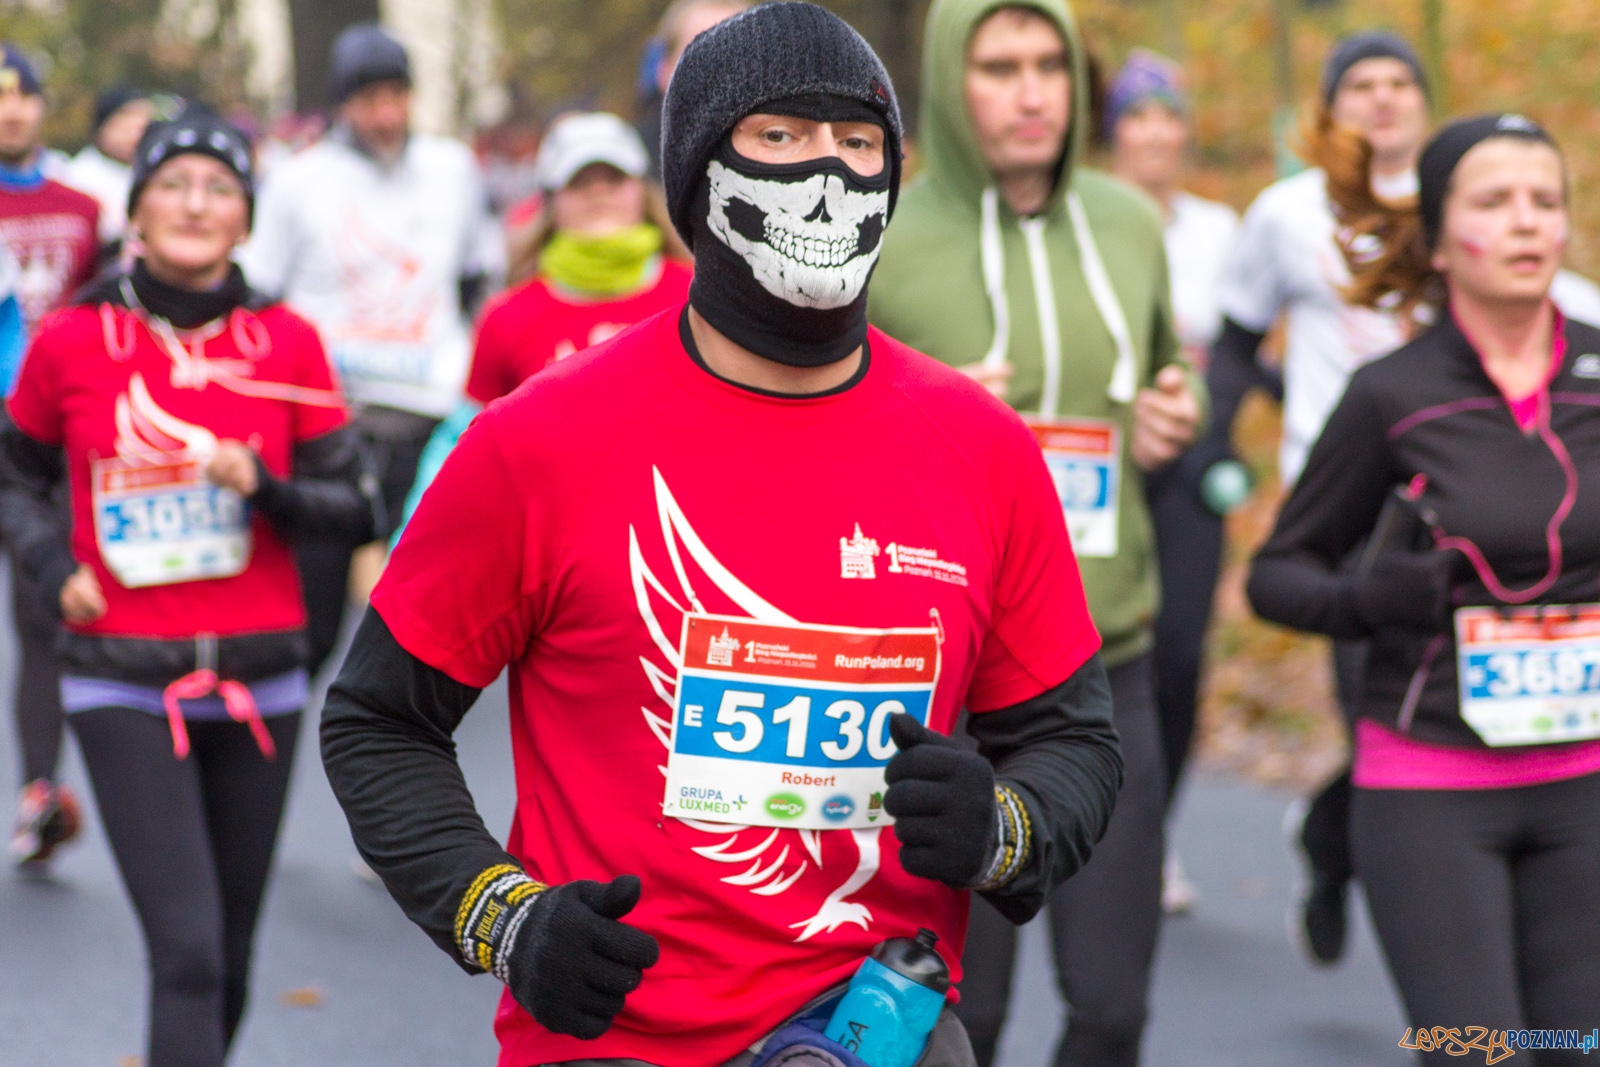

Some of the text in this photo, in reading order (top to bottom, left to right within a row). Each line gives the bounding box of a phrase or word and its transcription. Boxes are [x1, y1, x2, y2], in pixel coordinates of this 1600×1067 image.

[885, 542, 903, 573] 1
[744, 640, 756, 663] 1
[834, 654, 925, 671] RunPoland.org
[684, 689, 906, 761] E 5130
[781, 771, 836, 787] Robert
[680, 786, 723, 801] GRUPA
[679, 799, 730, 814] LUXMED
[475, 898, 504, 943] EVERLAST
